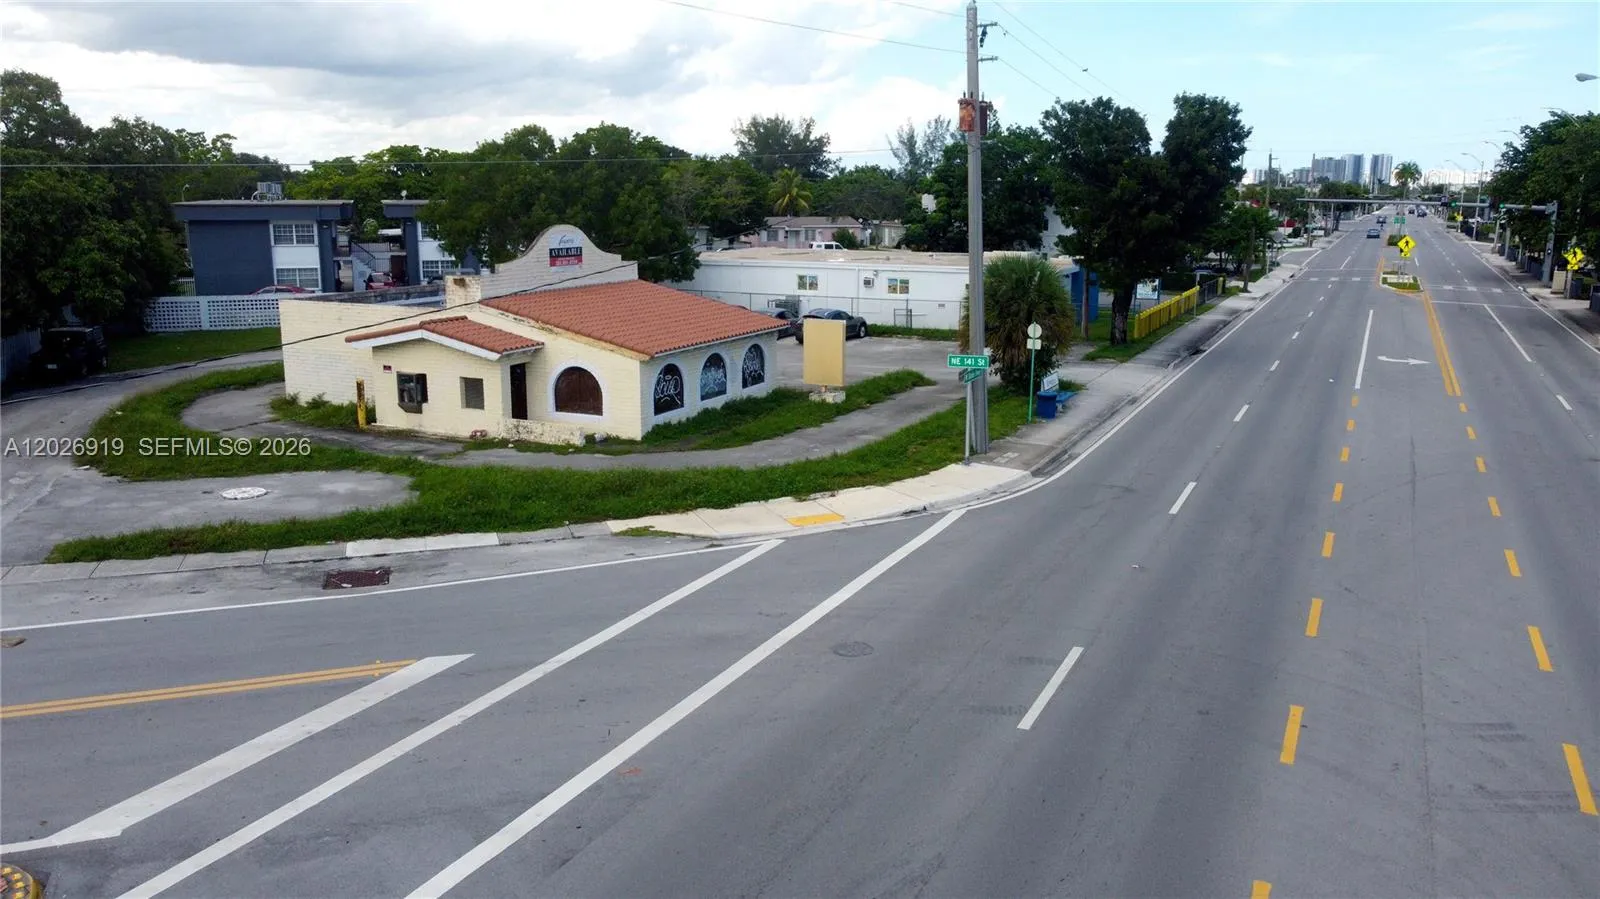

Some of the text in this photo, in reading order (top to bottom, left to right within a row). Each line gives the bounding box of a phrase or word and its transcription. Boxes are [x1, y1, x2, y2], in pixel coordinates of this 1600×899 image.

[551, 247, 581, 256] AVAILABLE
[951, 357, 985, 367] NE 141 St
